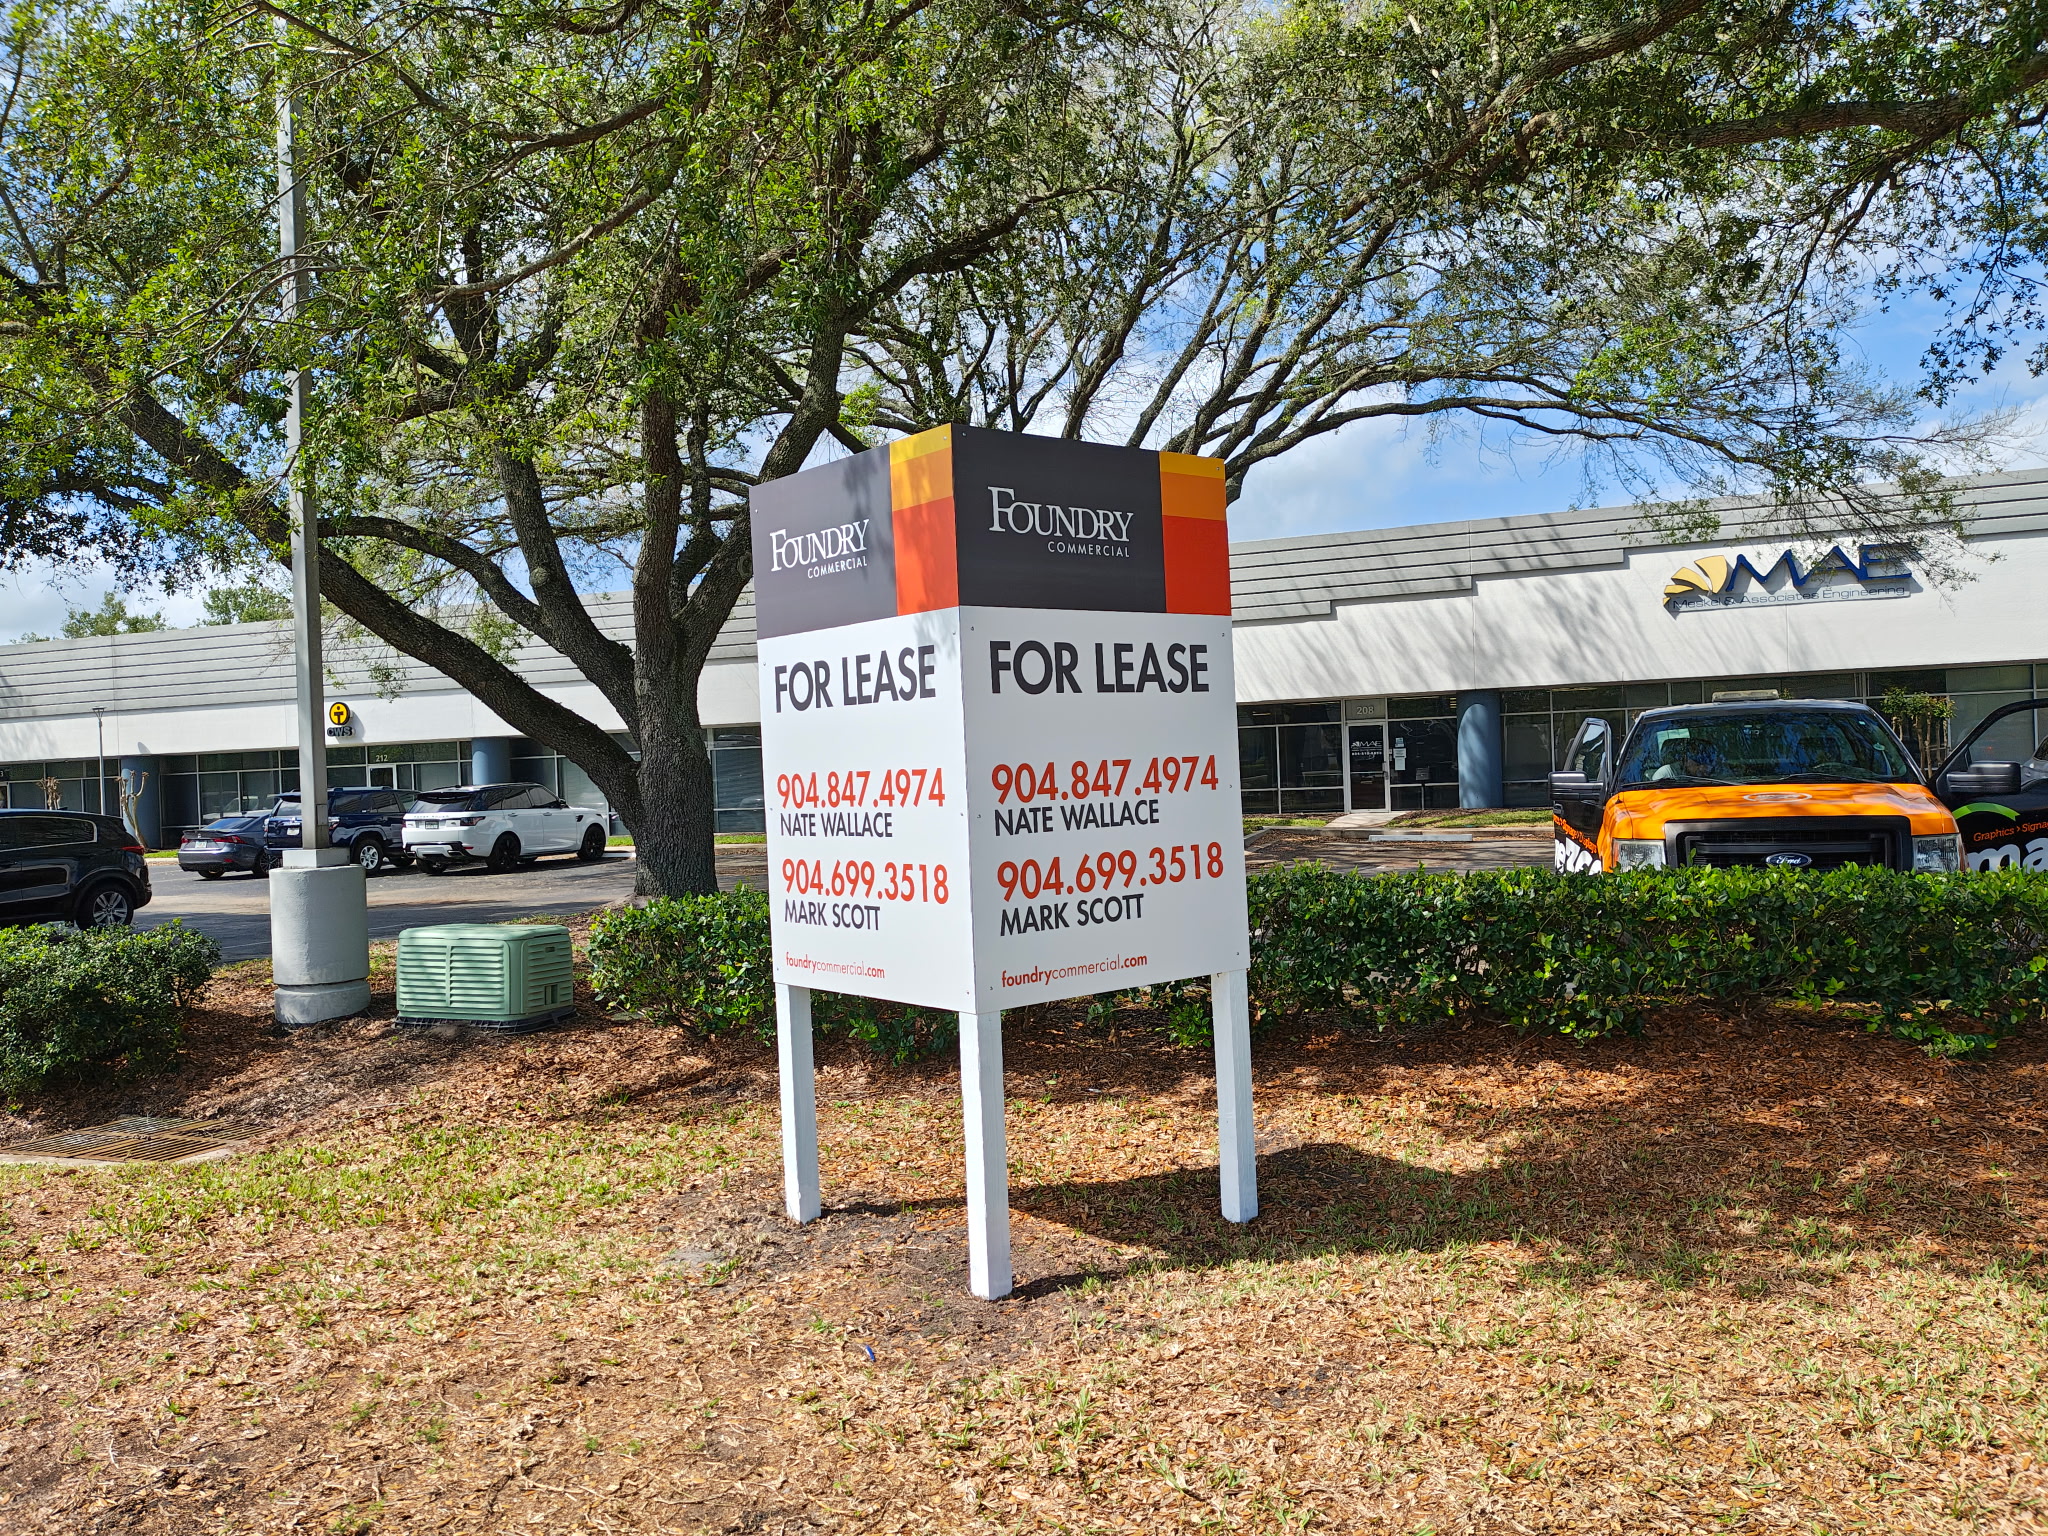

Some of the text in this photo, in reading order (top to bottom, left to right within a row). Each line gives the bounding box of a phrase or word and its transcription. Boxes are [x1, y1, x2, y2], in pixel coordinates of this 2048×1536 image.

[988, 487, 1134, 543] FOUNDRY
[770, 519, 870, 572] FOUNDRY
[1048, 541, 1130, 558] COMMERCIAL
[807, 558, 868, 579] COMMERCIAL
[1673, 598, 1720, 610] Meskel
[1740, 592, 1820, 604] Associates
[1822, 586, 1906, 600] Engineering
[775, 645, 937, 713] FOR LEASE
[990, 641, 1210, 694] FOR LEASE
[1356, 706, 1374, 715] 208
[327, 726, 353, 737] CWS
[375, 754, 388, 762] 212
[777, 768, 945, 809] 904.847.4974
[992, 755, 1219, 805] 904.847.4974
[780, 812, 893, 837] NATE WALLACE
[994, 799, 1160, 836] NATE WALLACE
[1973, 821, 2048, 842] Graphics Signa
[998, 842, 1224, 901] 904.699.3518
[1776, 855, 1802, 865] Ford
[782, 859, 949, 904] 904.699.3518
[784, 899, 880, 930] MARK SCOTT
[1000, 893, 1144, 937] MARK SCOTT
[786, 951, 885, 979] foundrycommercial.com
[1002, 953, 1147, 987] foundrycommercial.com
